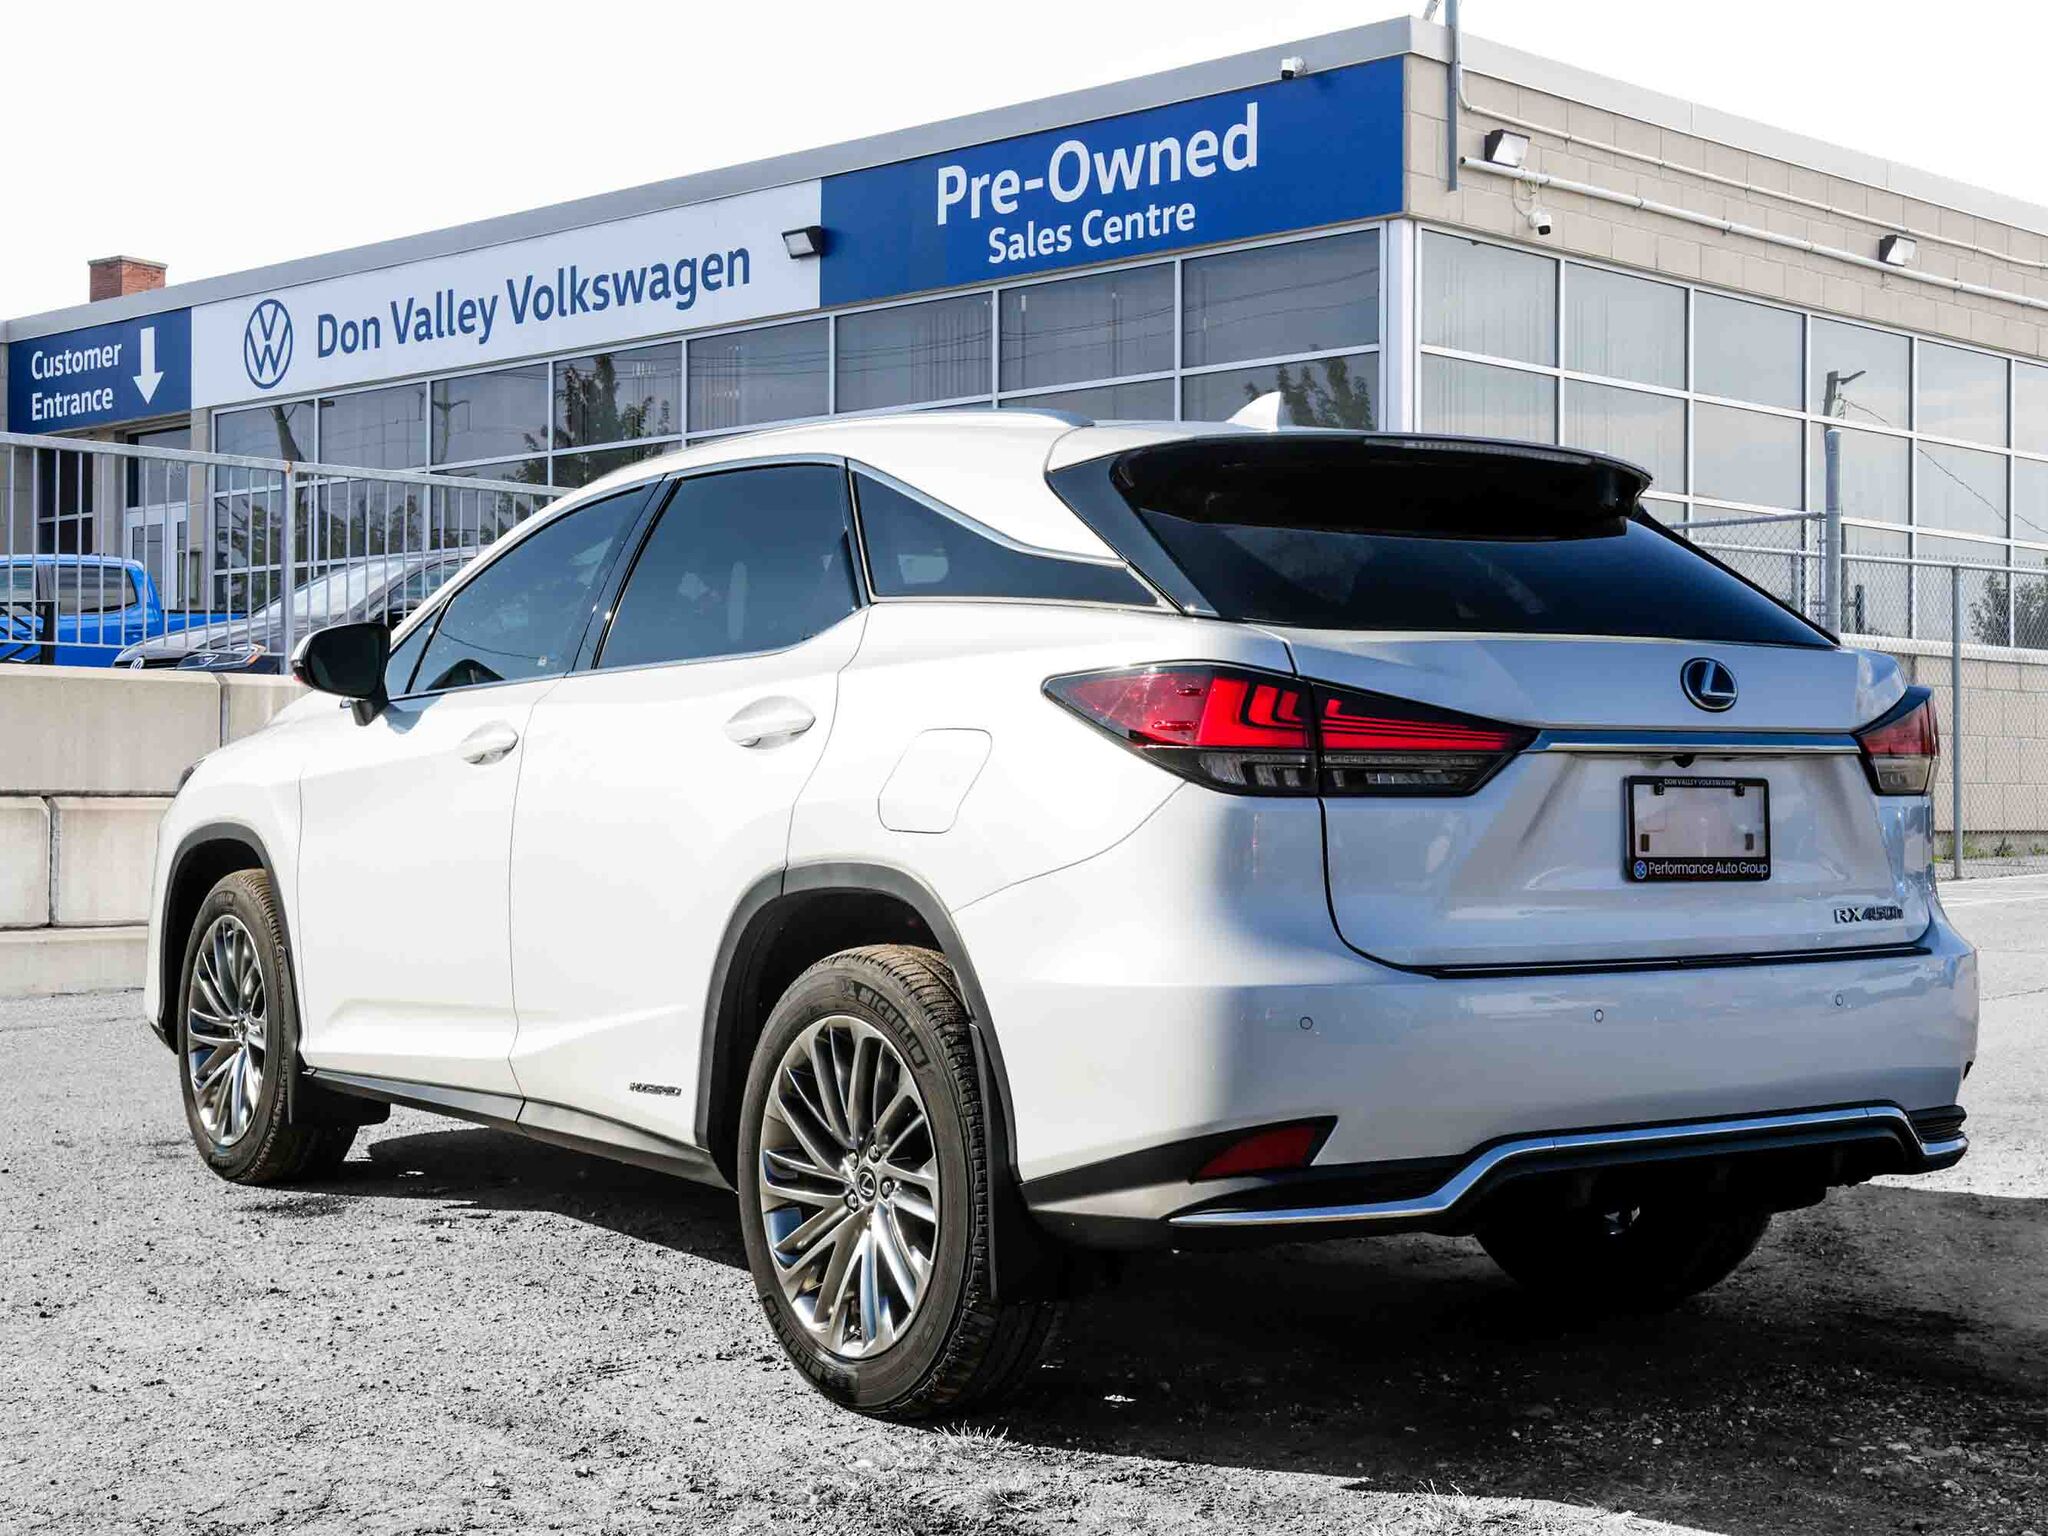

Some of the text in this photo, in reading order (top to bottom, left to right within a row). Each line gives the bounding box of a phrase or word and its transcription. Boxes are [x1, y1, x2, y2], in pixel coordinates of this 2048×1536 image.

[937, 101, 1259, 226] Pre-Owned
[988, 202, 1196, 264] Sales Centre
[317, 247, 750, 358] Don Valley Volkswagen
[31, 343, 123, 380] Customer
[31, 387, 114, 421] Entrance
[1648, 861, 1769, 878] Performance Auto Group
[1834, 907, 1861, 924] RX
